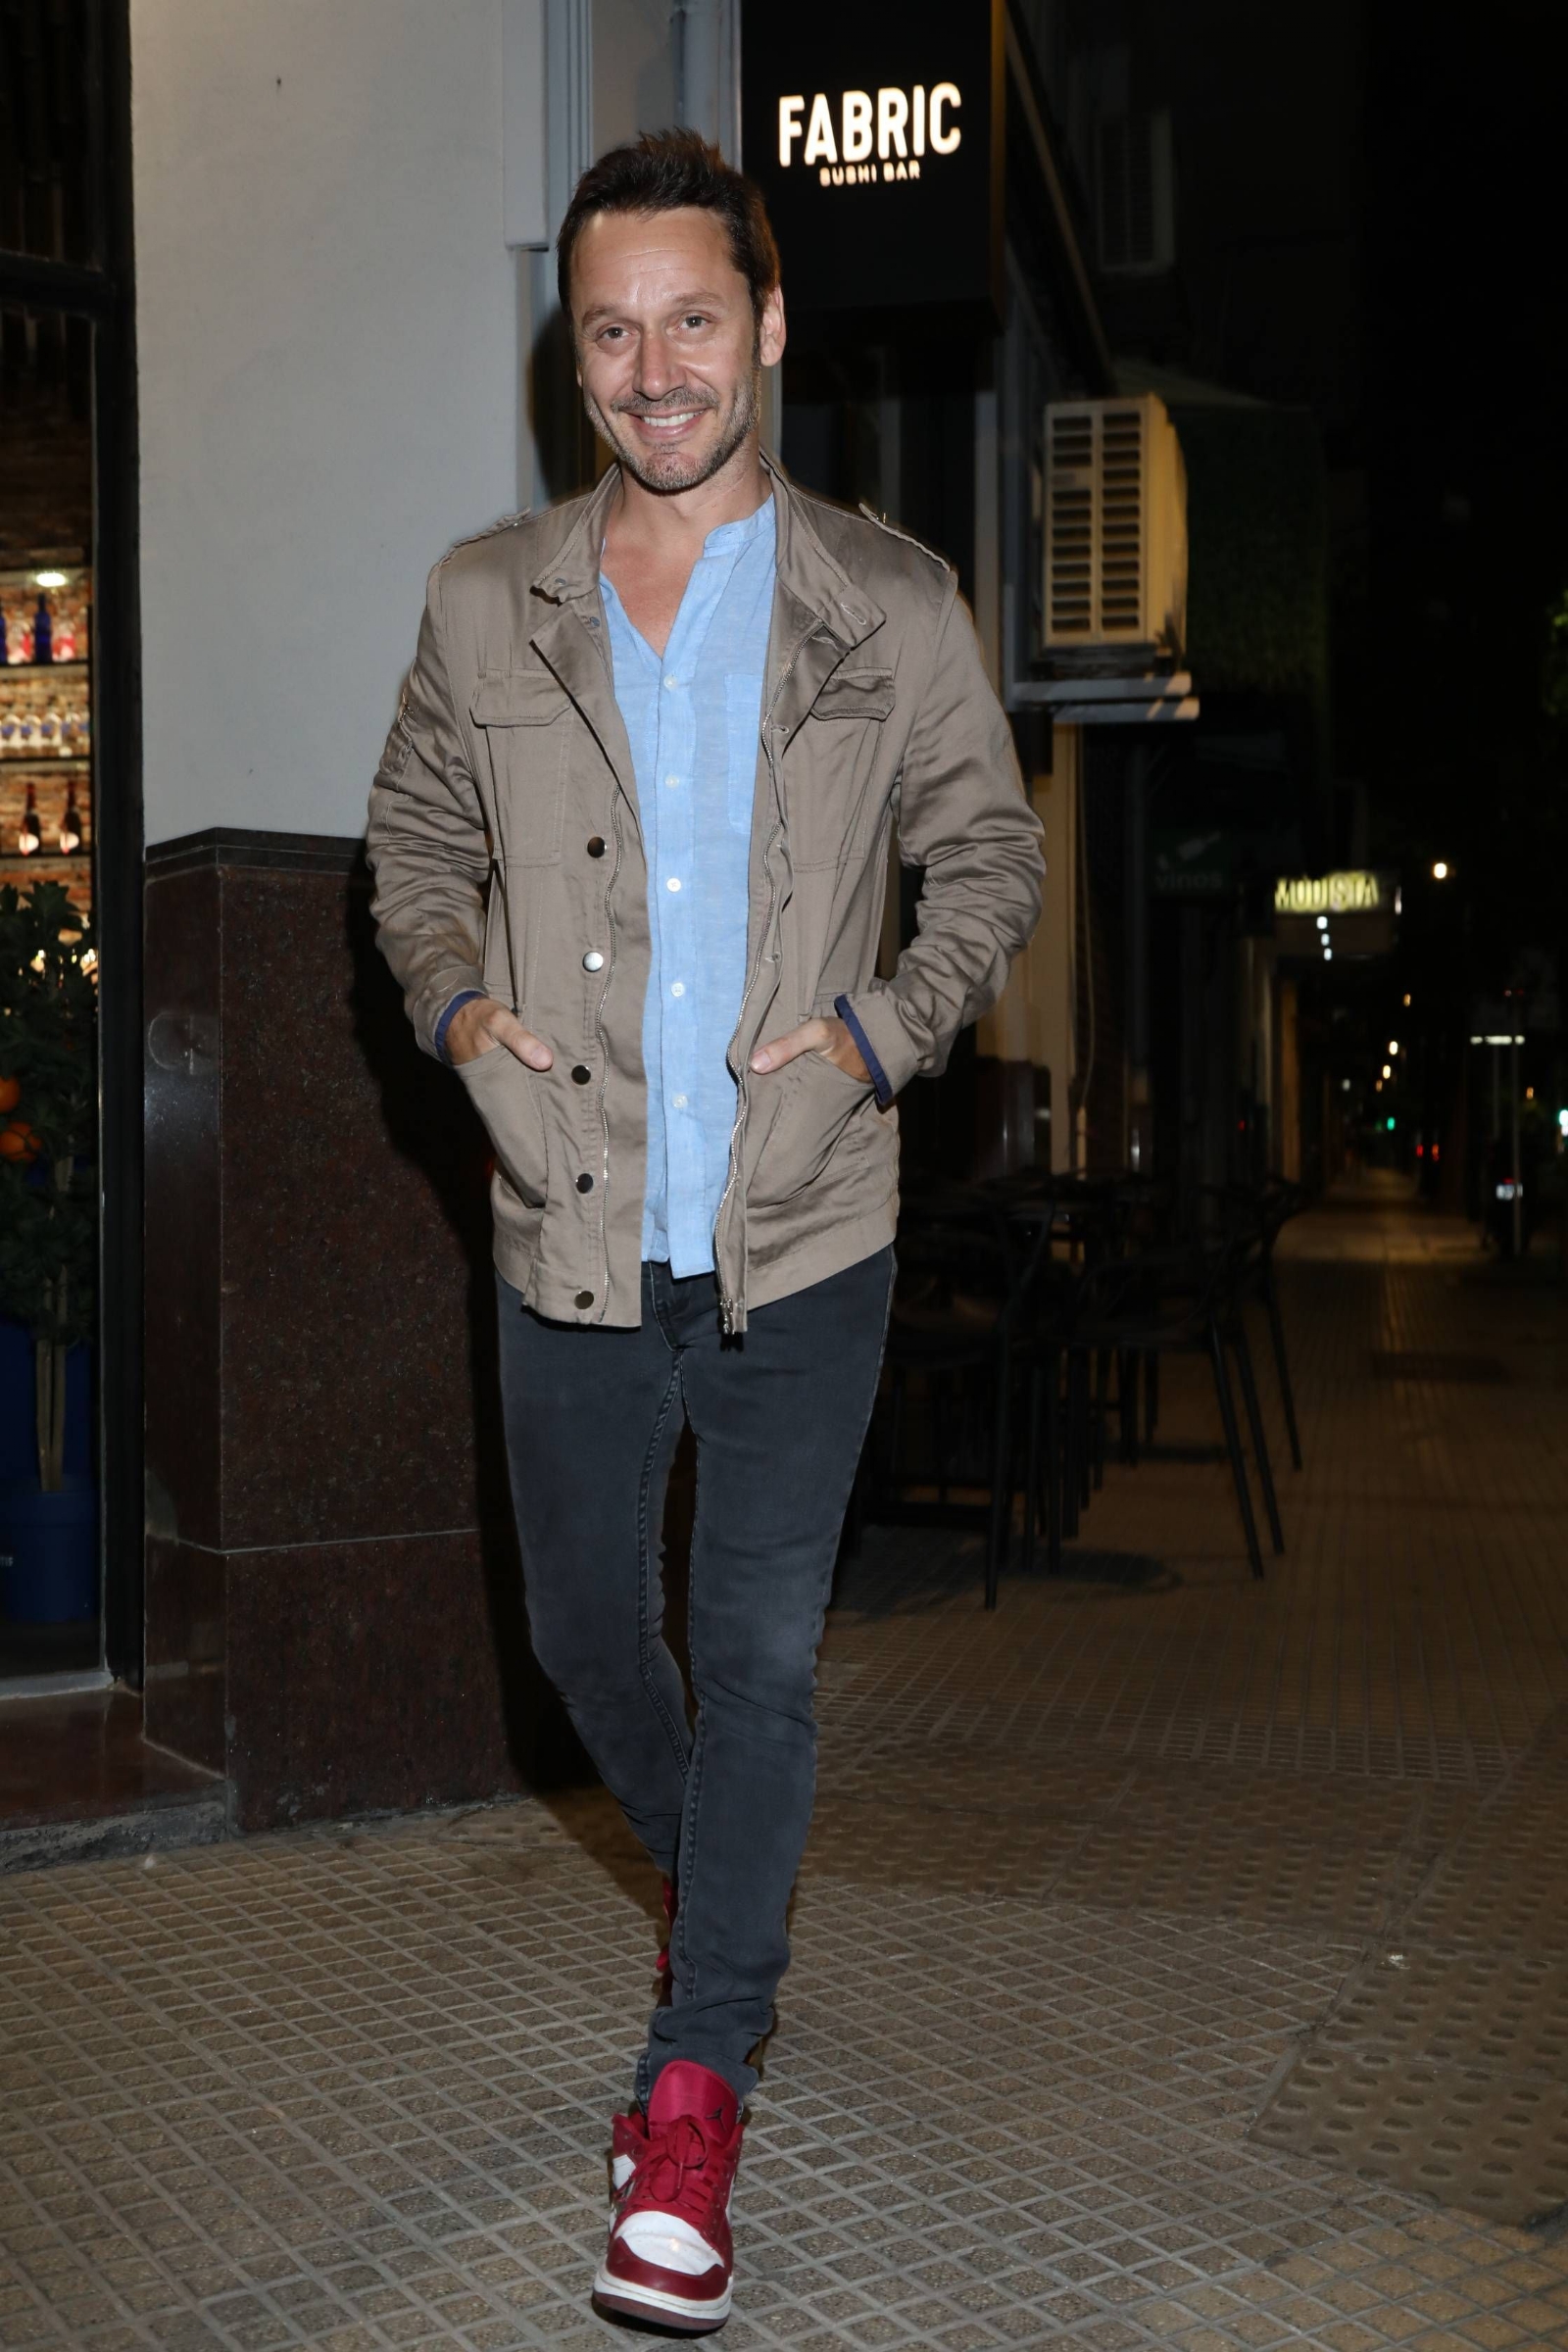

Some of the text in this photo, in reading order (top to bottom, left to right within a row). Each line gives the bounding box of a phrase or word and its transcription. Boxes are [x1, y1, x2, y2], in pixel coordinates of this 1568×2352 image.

[779, 81, 962, 168] FABRIC
[819, 160, 921, 187] SUSHI BAR
[1154, 871, 1223, 891] vinos
